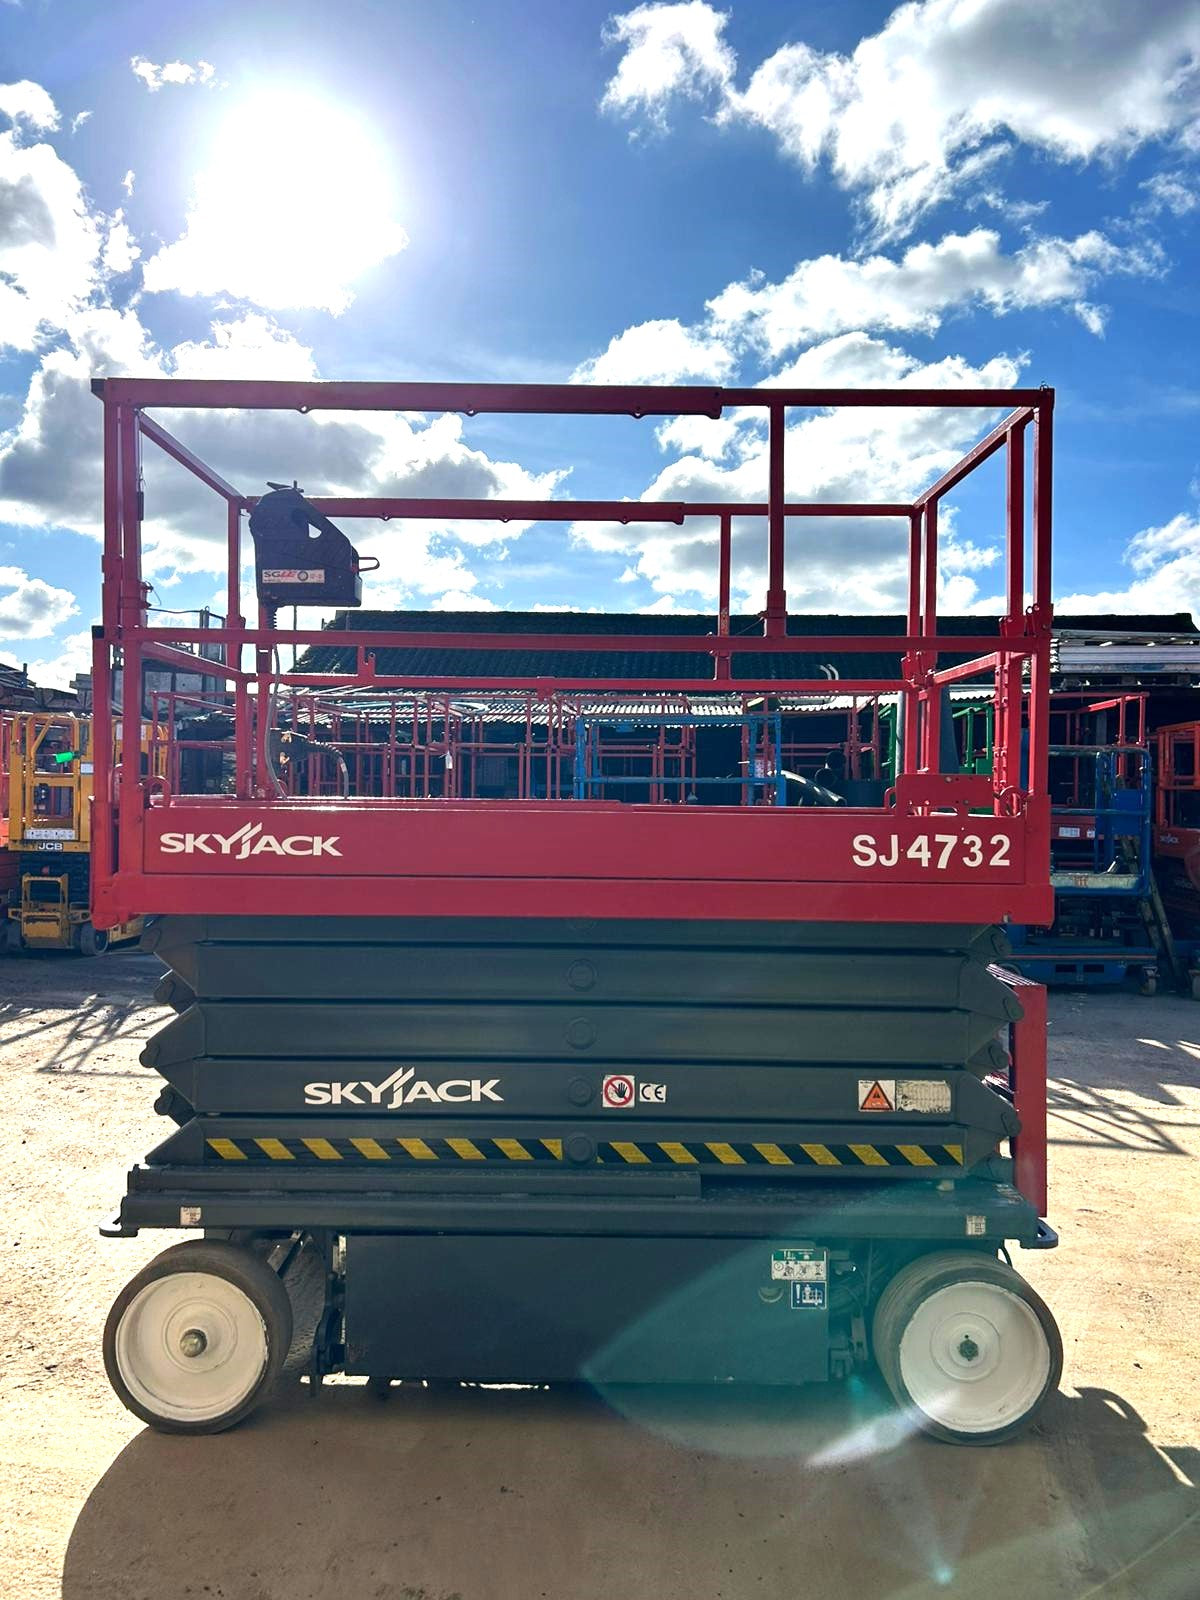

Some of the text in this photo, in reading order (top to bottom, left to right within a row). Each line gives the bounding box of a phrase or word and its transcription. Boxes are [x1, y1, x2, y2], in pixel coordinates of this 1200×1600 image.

[38, 842, 63, 850] JCB
[160, 822, 343, 859] SKYJACK
[303, 1067, 504, 1109] SKYJACK
[641, 1084, 664, 1100] CE
